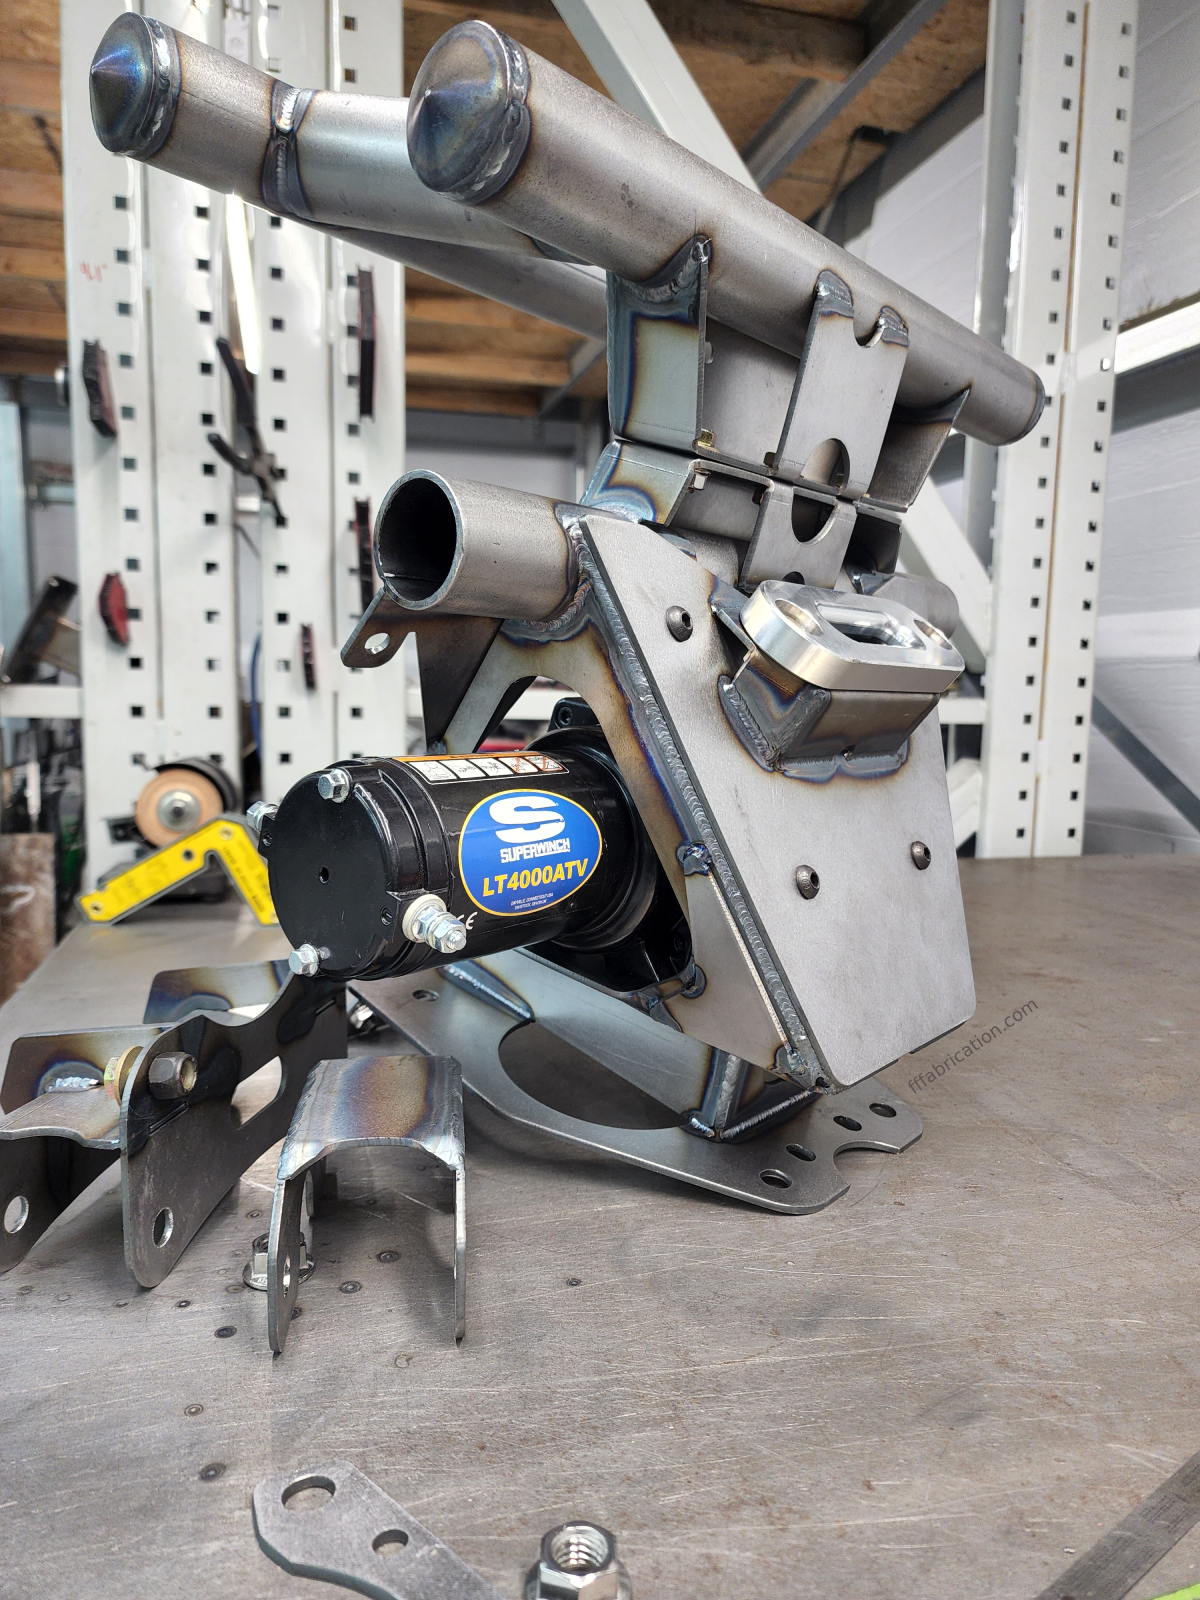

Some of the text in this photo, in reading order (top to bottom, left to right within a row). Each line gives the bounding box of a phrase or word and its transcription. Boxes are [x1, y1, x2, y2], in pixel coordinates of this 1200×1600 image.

[489, 796, 565, 843] S
[500, 838, 570, 863] SUPERWINCH
[482, 858, 588, 896] LT4000ATV
